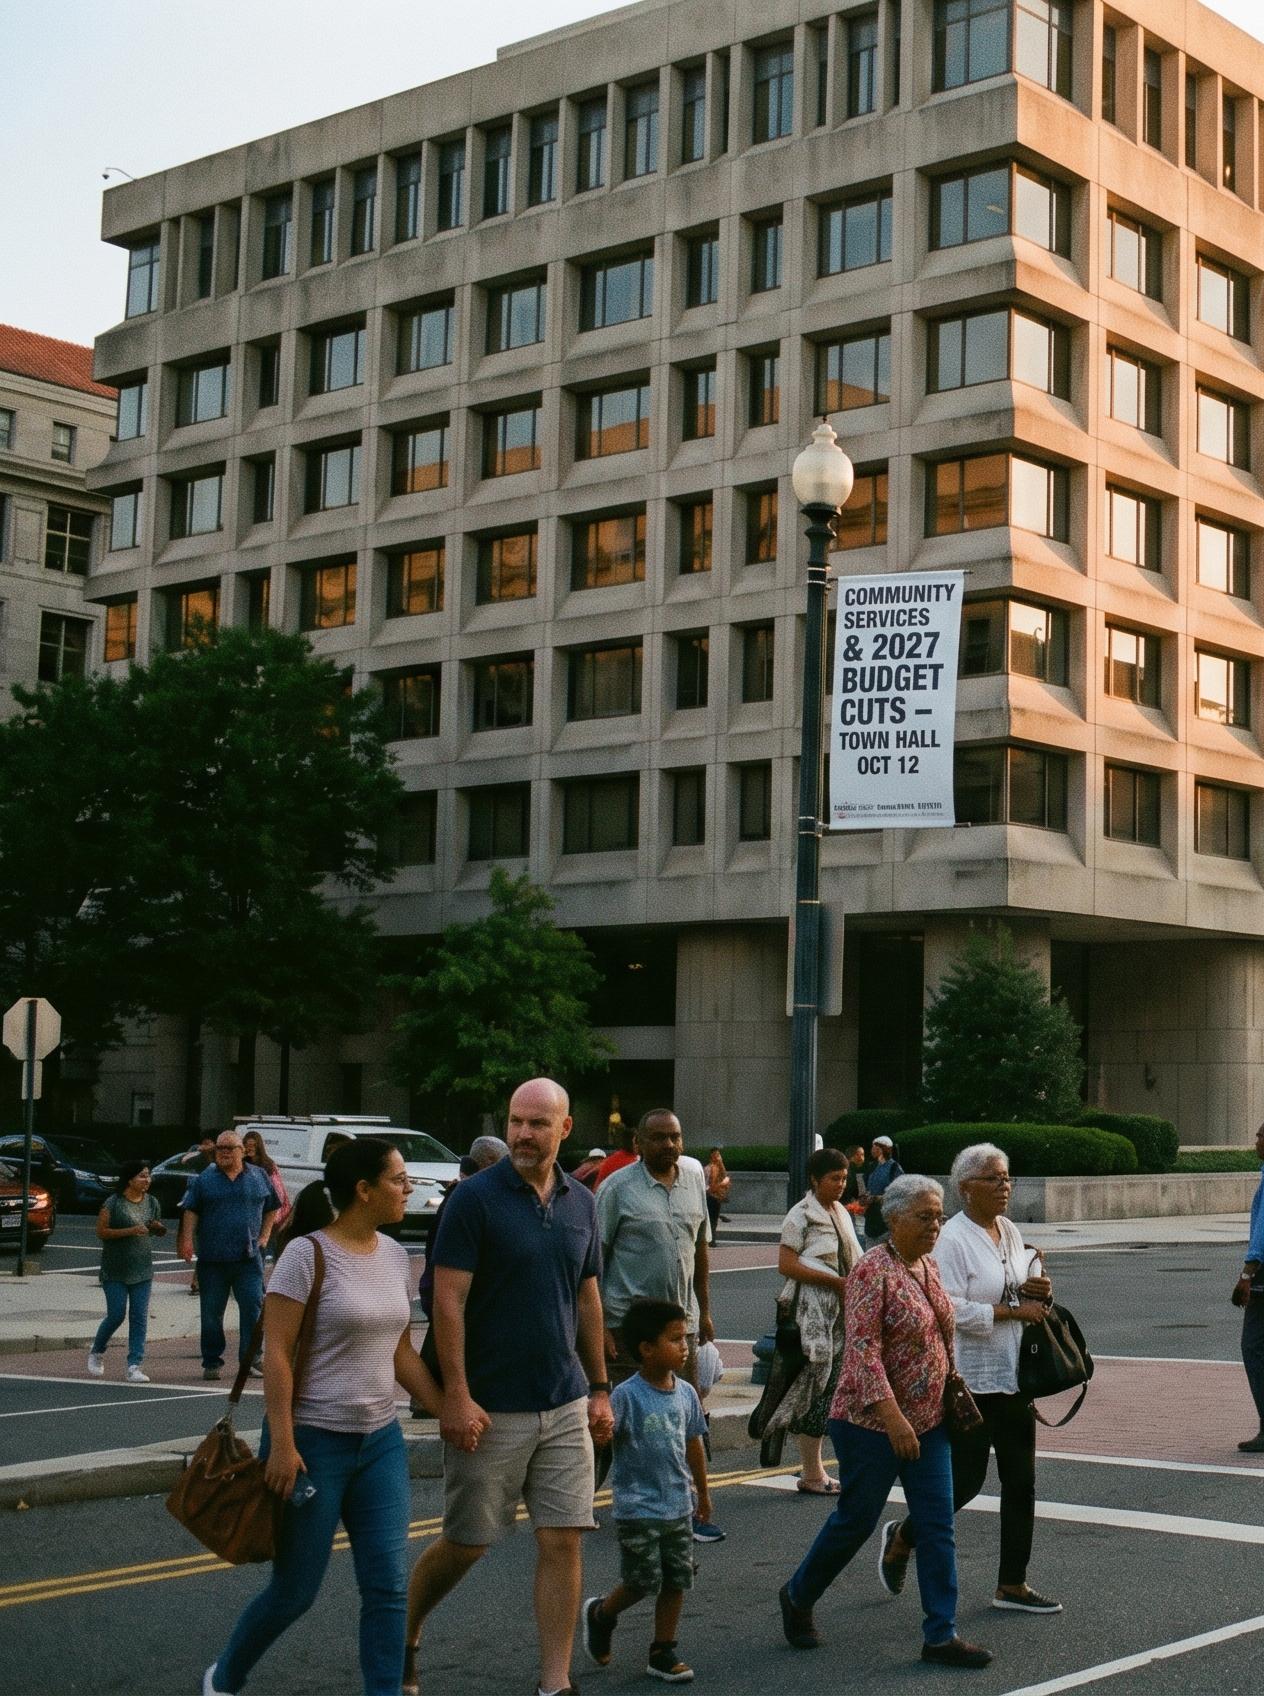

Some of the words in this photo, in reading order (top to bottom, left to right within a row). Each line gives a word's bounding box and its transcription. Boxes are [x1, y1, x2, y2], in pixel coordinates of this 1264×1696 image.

[844, 583, 955, 606] COMMUNITY
[844, 607, 930, 629] SERVICES
[842, 634, 863, 661] &
[871, 631, 940, 660] 2027
[841, 663, 944, 693] BUDGET
[840, 696, 905, 725] CUTS
[839, 730, 889, 750] TOWN
[895, 729, 940, 748] HALL
[857, 755, 891, 775] OCT
[897, 755, 919, 774] 12
